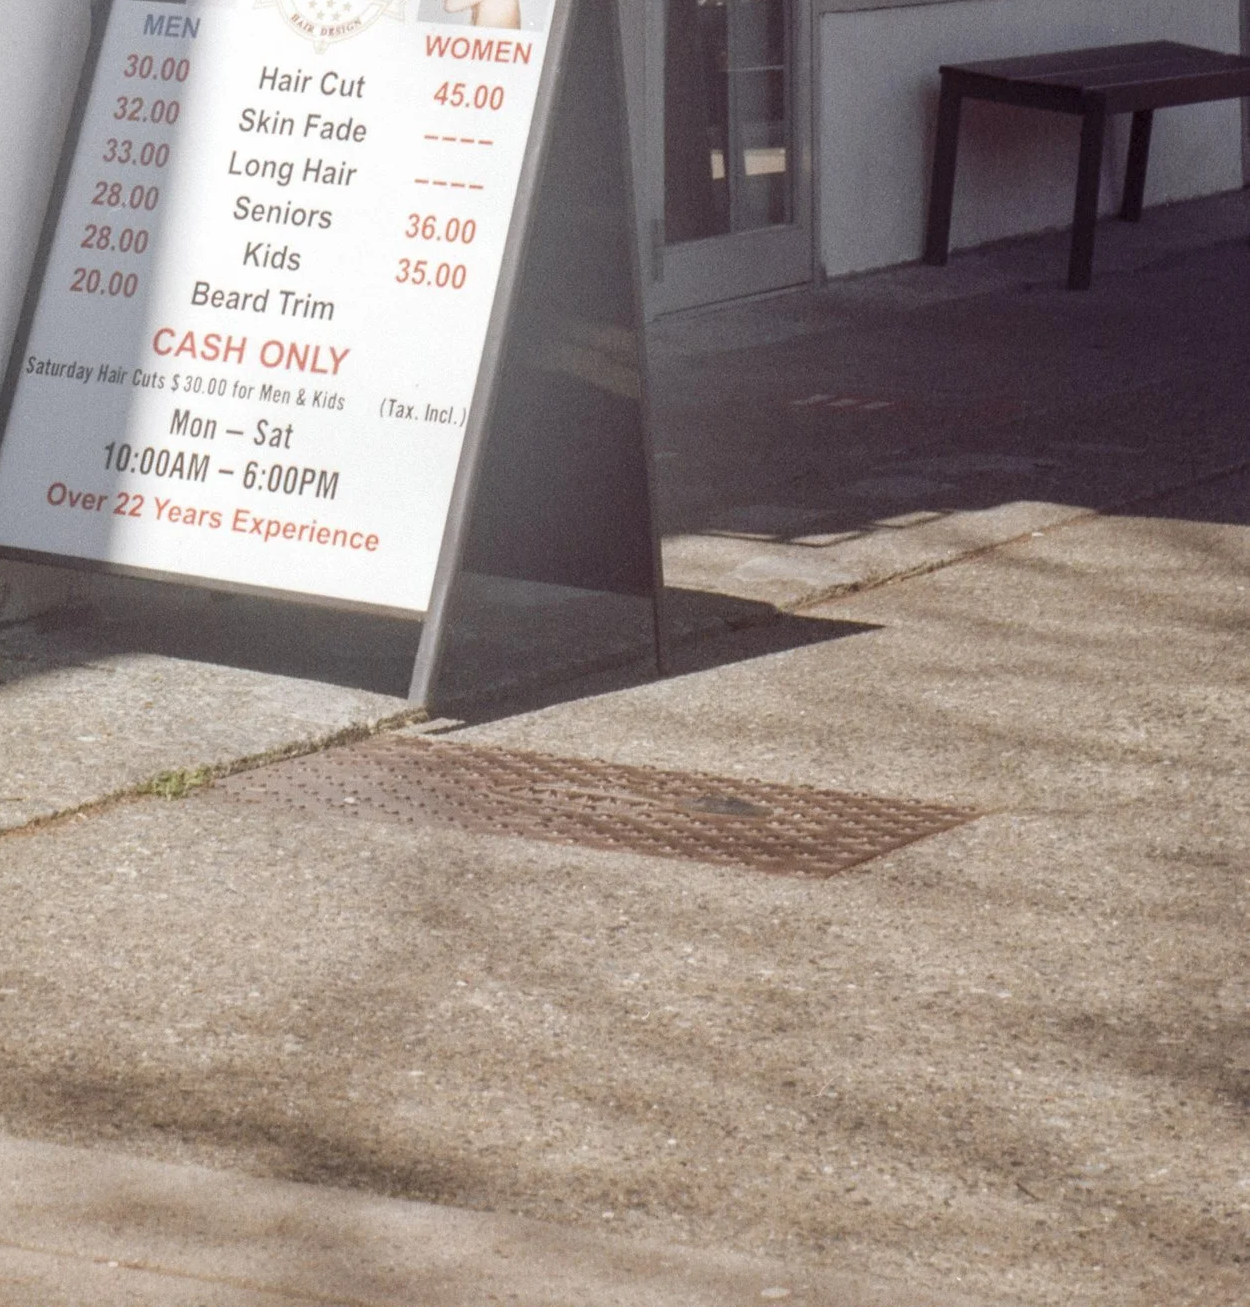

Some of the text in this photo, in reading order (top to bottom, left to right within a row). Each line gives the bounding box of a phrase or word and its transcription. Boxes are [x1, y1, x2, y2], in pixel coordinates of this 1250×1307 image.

[143, 14, 533, 65] MEN WOMEN
[291, 13, 363, 36] HAIR DESIGN
[123, 53, 505, 111] 30.00 Hair Cut 45.00
[113, 96, 181, 125] 32.00
[238, 107, 295, 136] Skin
[303, 113, 368, 143] Fade
[102, 138, 170, 168] 33.00
[228, 150, 294, 187] Long
[302, 157, 358, 186] Hair
[91, 181, 477, 245] 28.00 Seniors 36.00
[80, 223, 467, 290] 28.00 Kids 35.00
[69, 267, 336, 321] 20.00 Beard Trim
[152, 327, 351, 376] CASH ONLY
[25, 355, 93, 385] Saturday
[97, 363, 128, 385] Hair
[132, 370, 165, 390] Cuts
[232, 380, 255, 400] for
[259, 384, 291, 406] Men
[296, 389, 307, 407] &
[312, 390, 345, 411] Kids
[379, 397, 419, 422] (Tax.
[425, 402, 468, 428] Incl.)
[170, 408, 218, 440] Mon
[253, 419, 294, 450] Sat
[102, 441, 210, 484] 10:00AM
[242, 461, 341, 501] 6:00PM
[46, 481, 381, 553] Over 22 Years Experience
